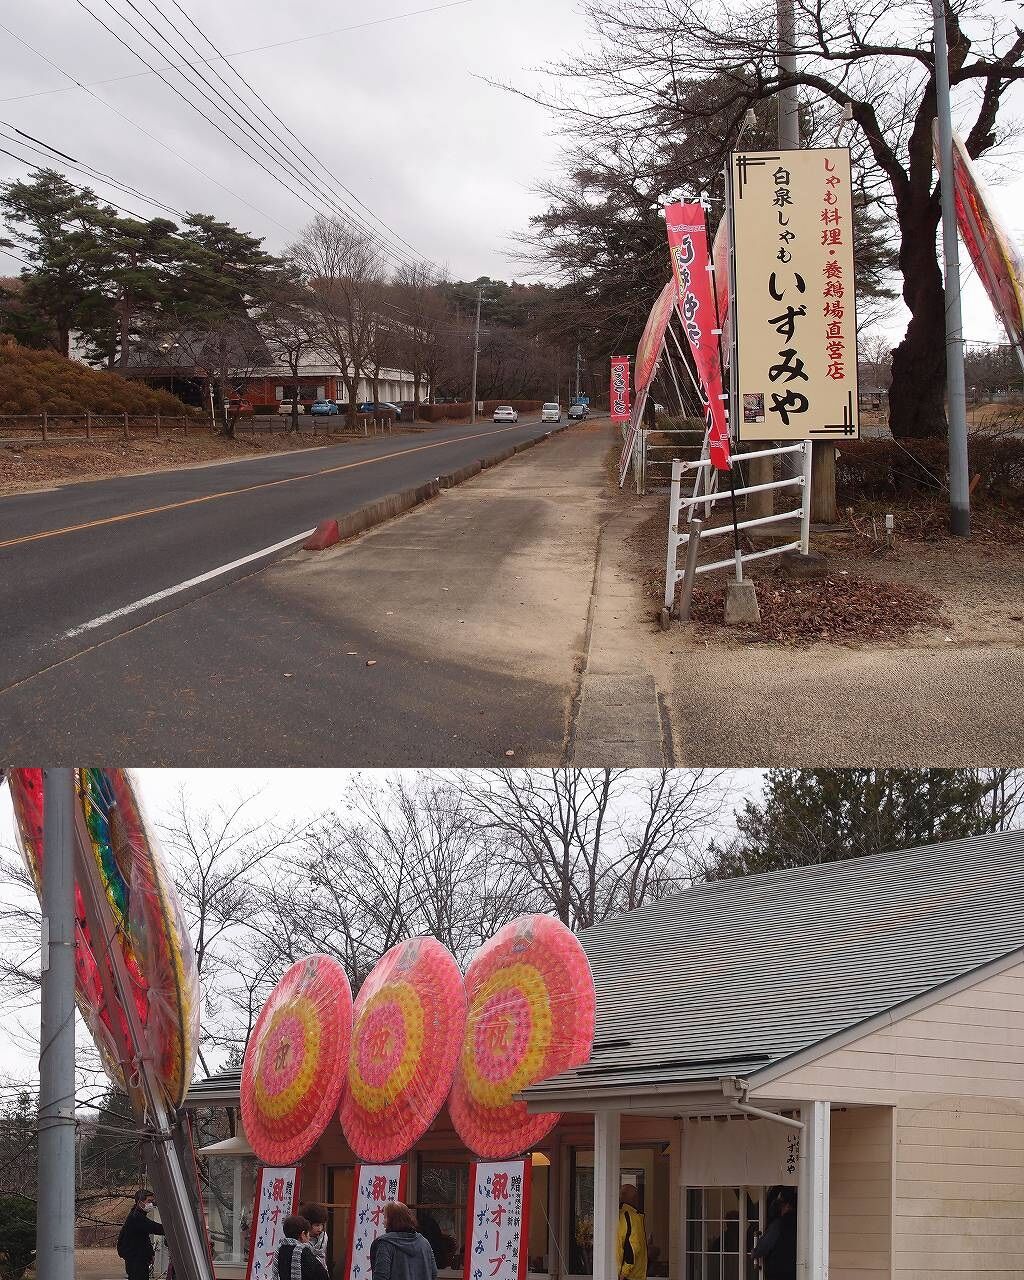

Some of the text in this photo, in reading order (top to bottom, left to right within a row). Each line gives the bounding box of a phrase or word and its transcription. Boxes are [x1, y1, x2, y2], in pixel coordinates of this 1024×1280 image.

[768, 271, 809, 426] いずみや
[820, 157, 845, 381] しゃも料理・養鶏場直営店
